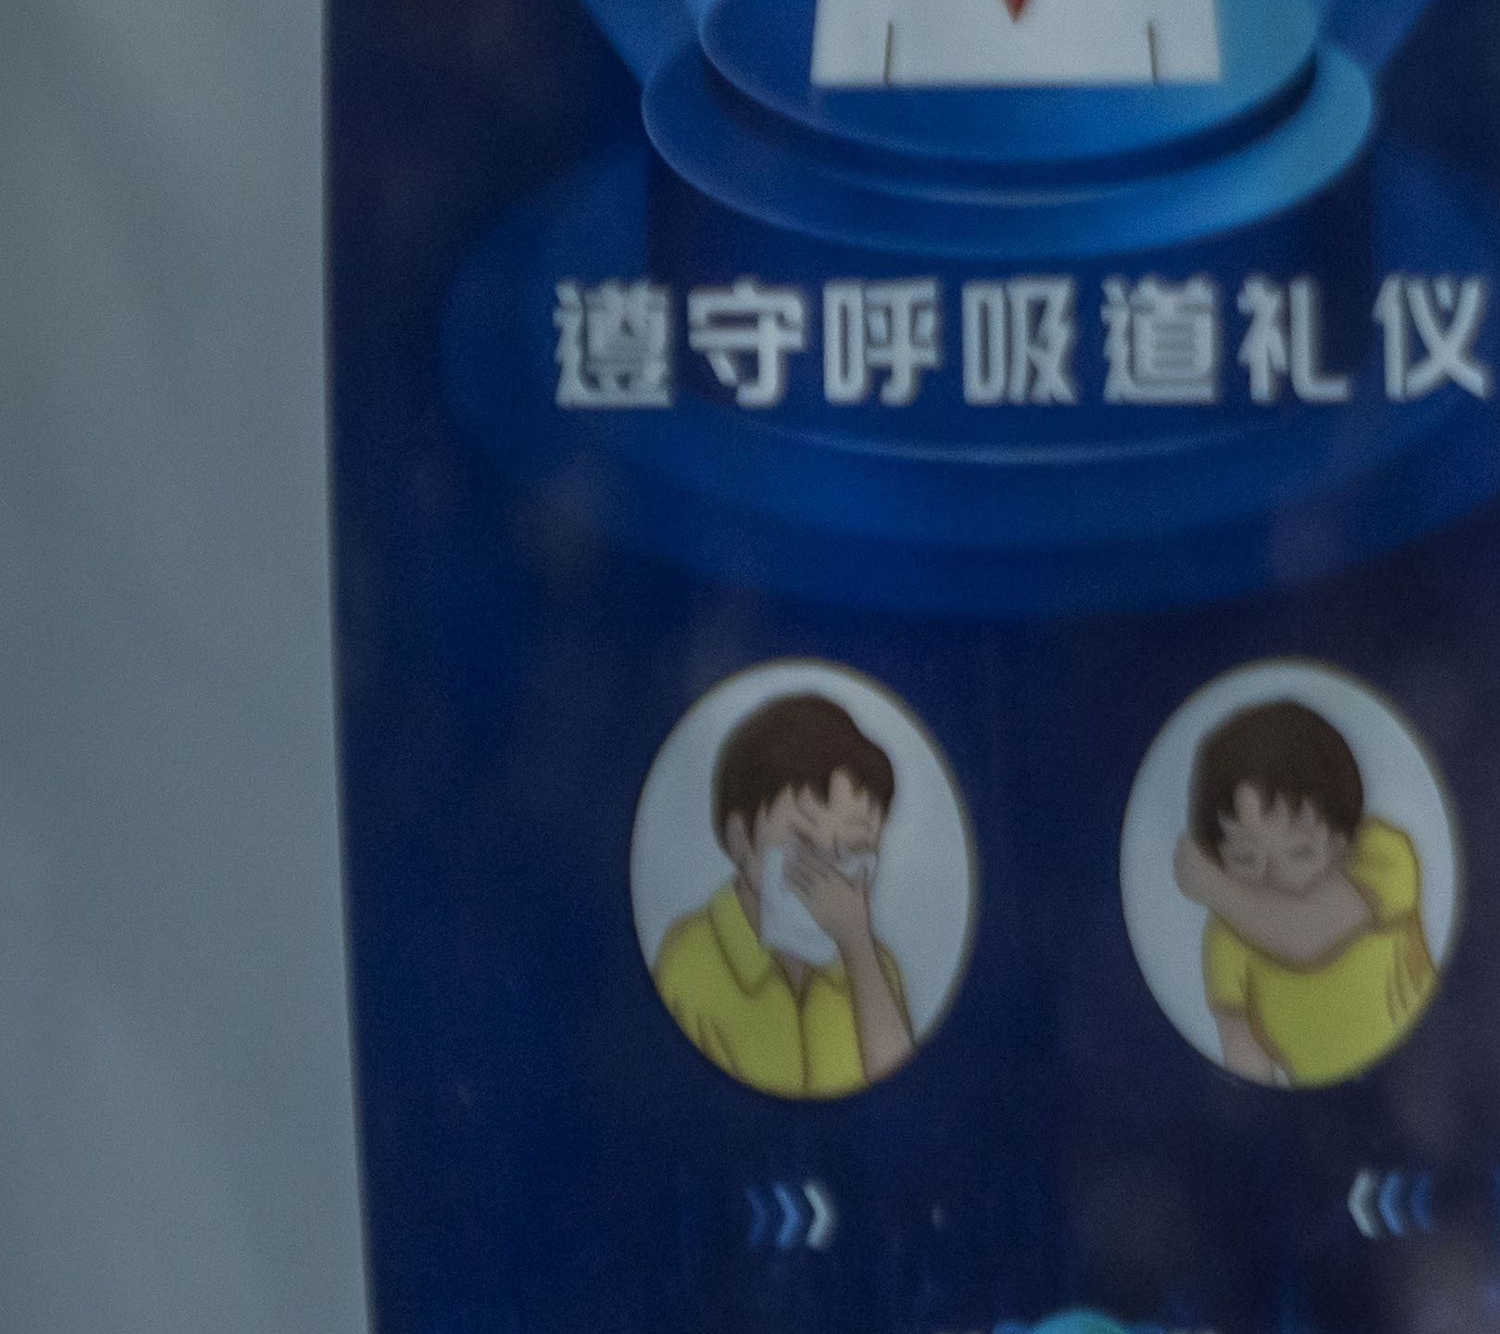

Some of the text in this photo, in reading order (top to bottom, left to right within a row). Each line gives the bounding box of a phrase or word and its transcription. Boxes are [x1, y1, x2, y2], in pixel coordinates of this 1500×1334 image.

[554, 275, 1492, 410] 遵守呼吸道礼仪
